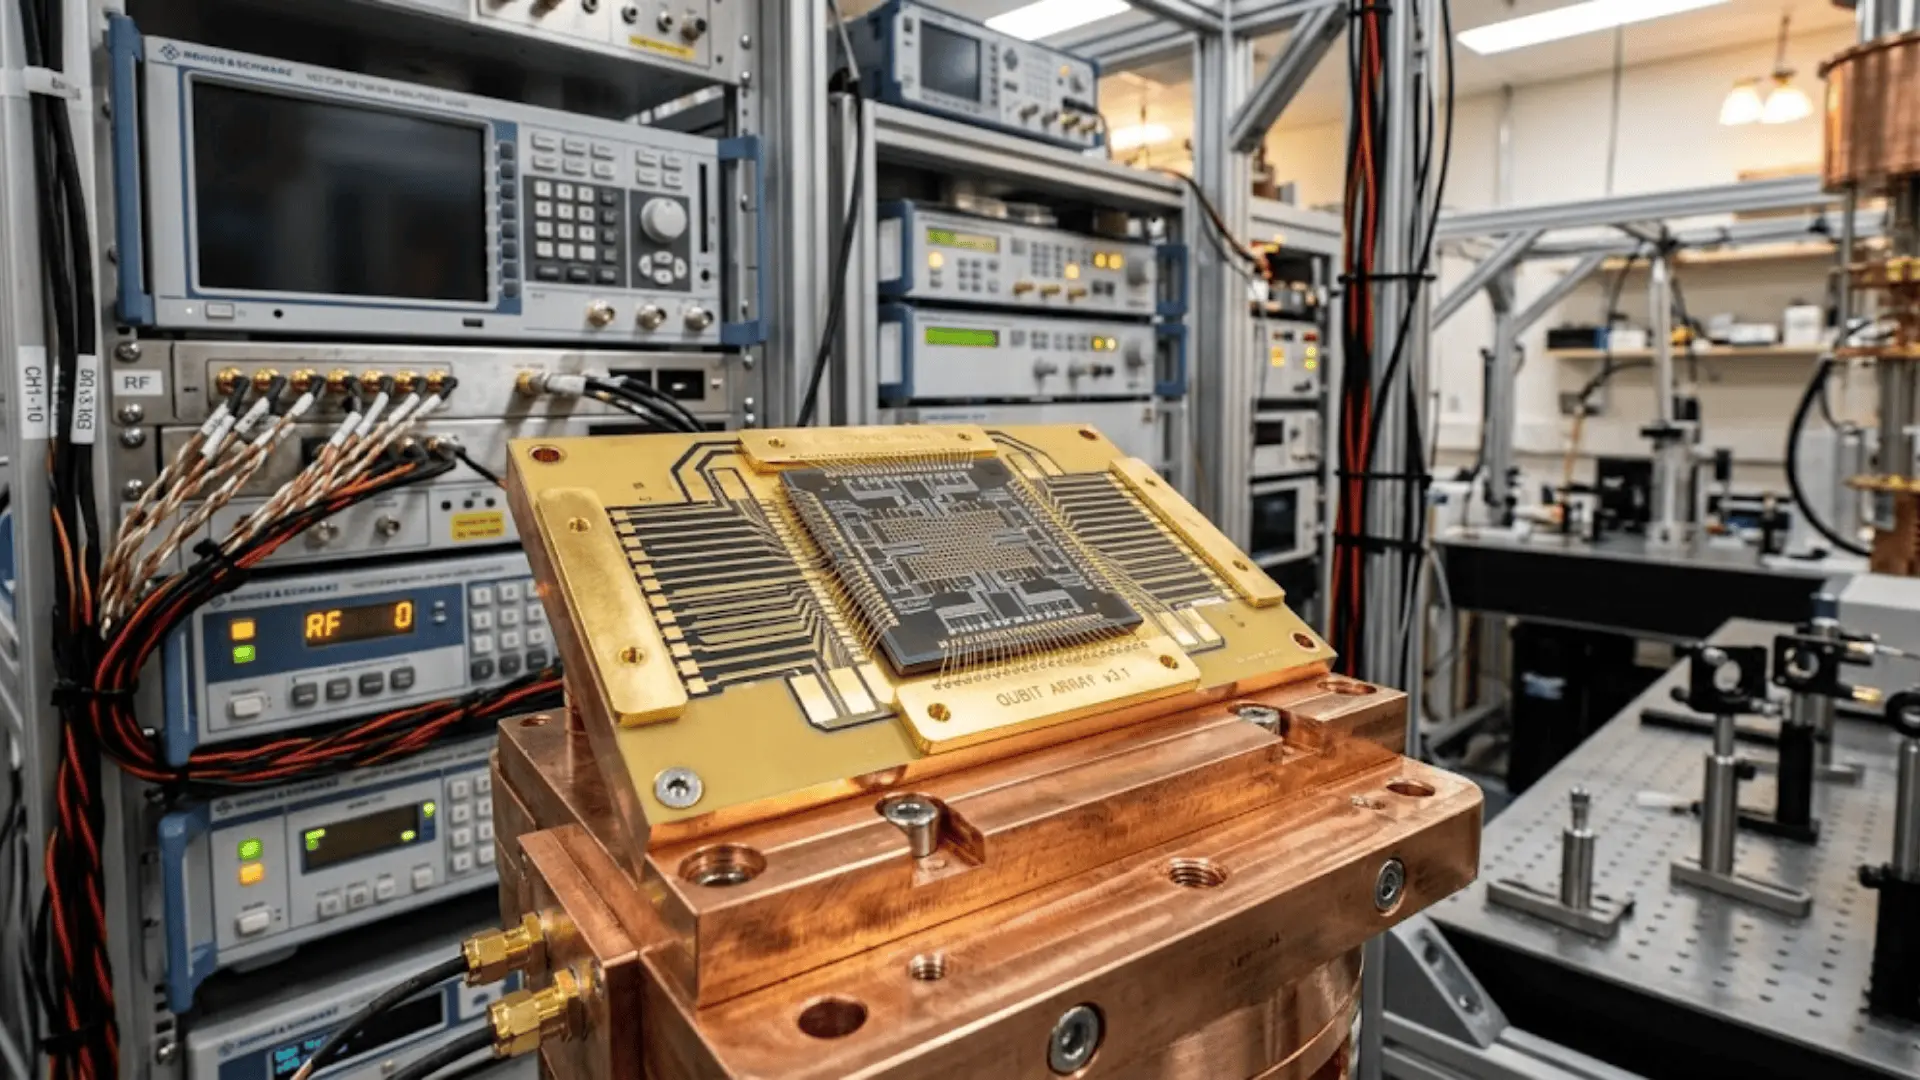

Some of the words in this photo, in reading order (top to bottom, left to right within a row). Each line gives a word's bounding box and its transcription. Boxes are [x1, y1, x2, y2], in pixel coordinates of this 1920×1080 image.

[25, 366, 44, 423] CH1-10
[124, 376, 151, 390] RF
[306, 610, 342, 640] RF
[394, 601, 413, 629] 0
[996, 685, 1044, 707] QUBIT
